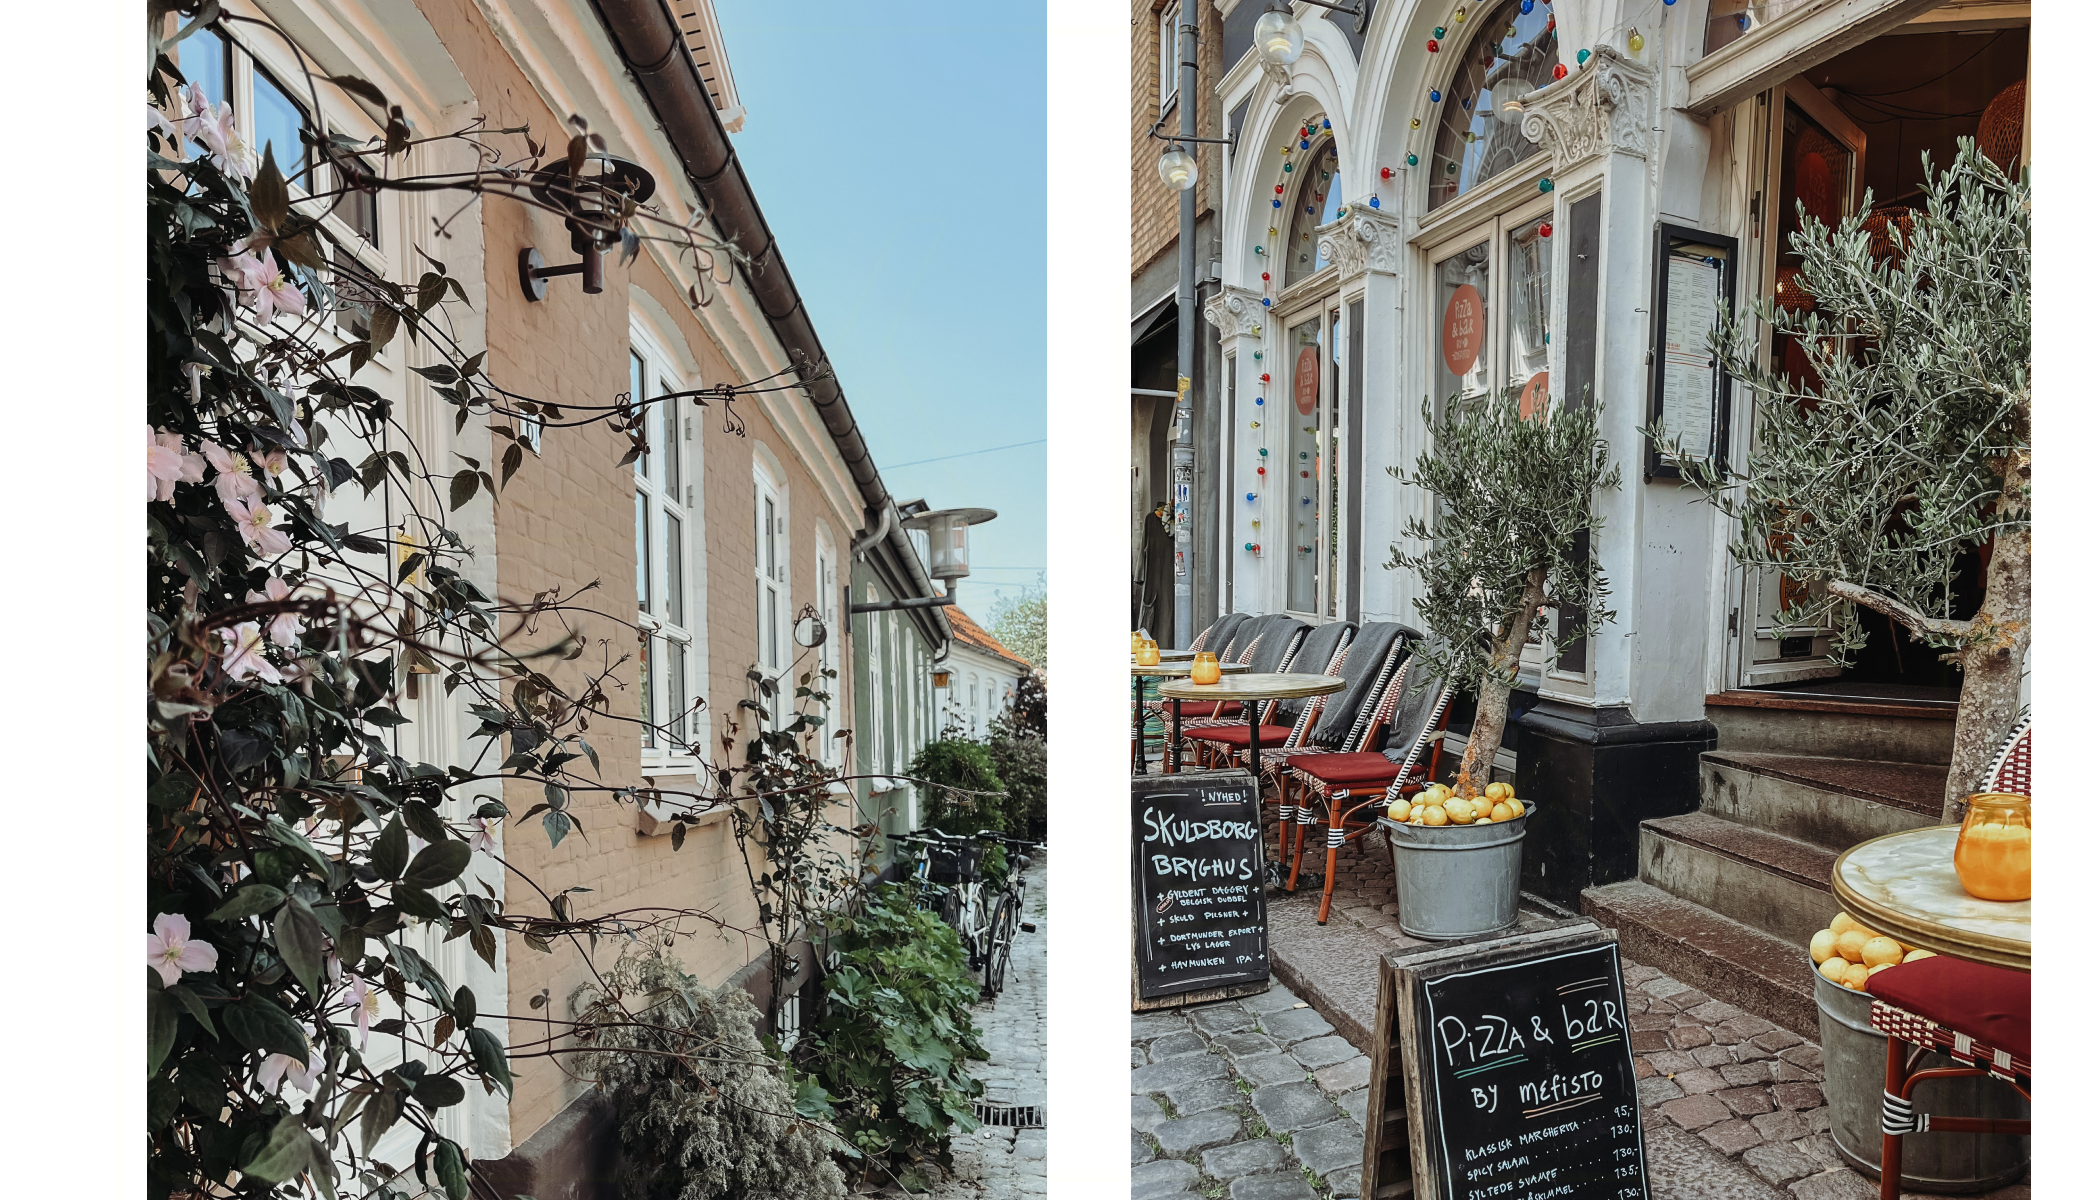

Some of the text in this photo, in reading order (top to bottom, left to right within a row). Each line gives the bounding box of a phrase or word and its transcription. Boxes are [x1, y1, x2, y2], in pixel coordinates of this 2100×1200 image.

[1454, 299, 1473, 319] Pizza
[1452, 322, 1459, 338] &
[1143, 806, 1258, 847] SKULDBORG
[1151, 854, 1253, 881] BRYGHUS
[1167, 885, 1249, 900] GYLDENT DAGGRY
[1179, 897, 1213, 906] BELGISK
[1217, 895, 1247, 903] DUBBEL
[1169, 911, 1240, 924] SKULD PILSNER
[1170, 926, 1257, 942] DORTMUNDER EXPORT
[1205, 940, 1231, 949] LAGER
[1170, 955, 1253, 970] HAVMUNKEN IPA
[1530, 1015, 1554, 1044] &
[1464, 1138, 1513, 1161] KLASSISK
[1519, 1121, 1580, 1145] MARGHERITA
[1467, 1163, 1494, 1182] SPICY
[1497, 1155, 1530, 1172] SALAMI
[1468, 1181, 1514, 1200] SYLTEDE
[1518, 1168, 1558, 1189] SVAMPE
